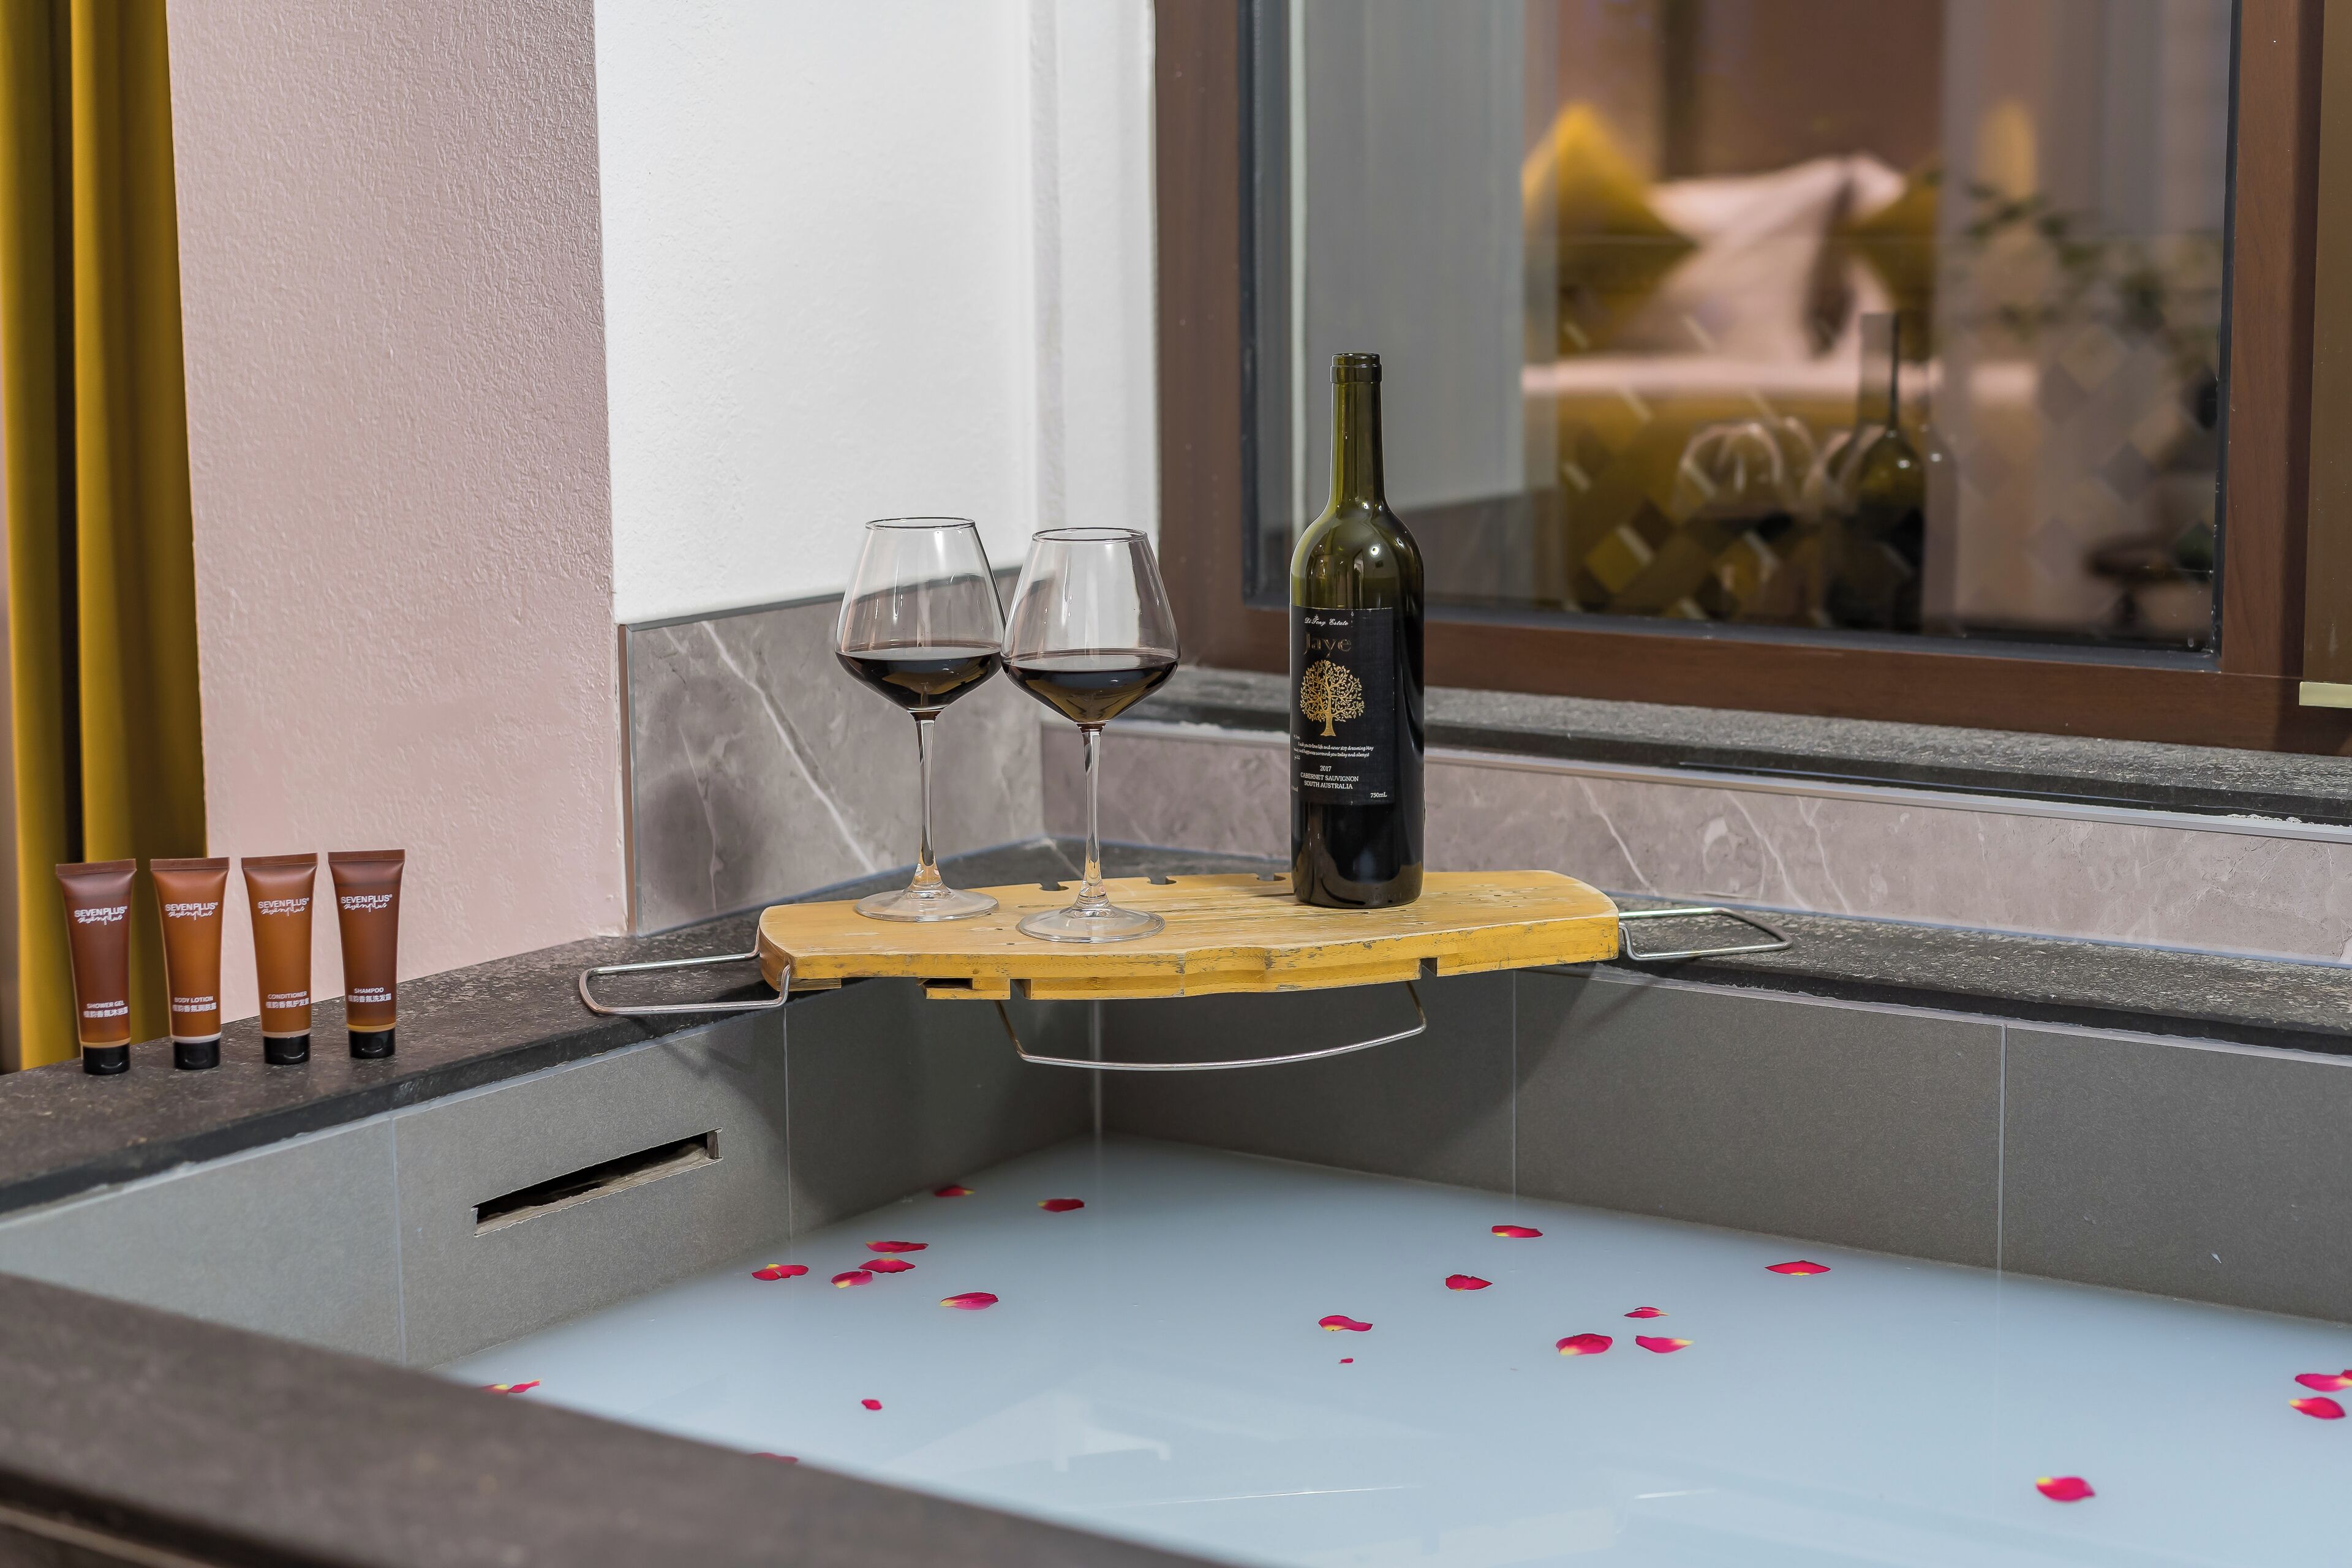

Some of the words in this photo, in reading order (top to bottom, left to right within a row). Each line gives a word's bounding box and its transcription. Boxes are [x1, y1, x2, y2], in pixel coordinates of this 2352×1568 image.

[1303, 630, 1351, 658] Jaye
[1300, 772, 1324, 781] CABERNET
[268, 990, 307, 999] CONDITIONER
